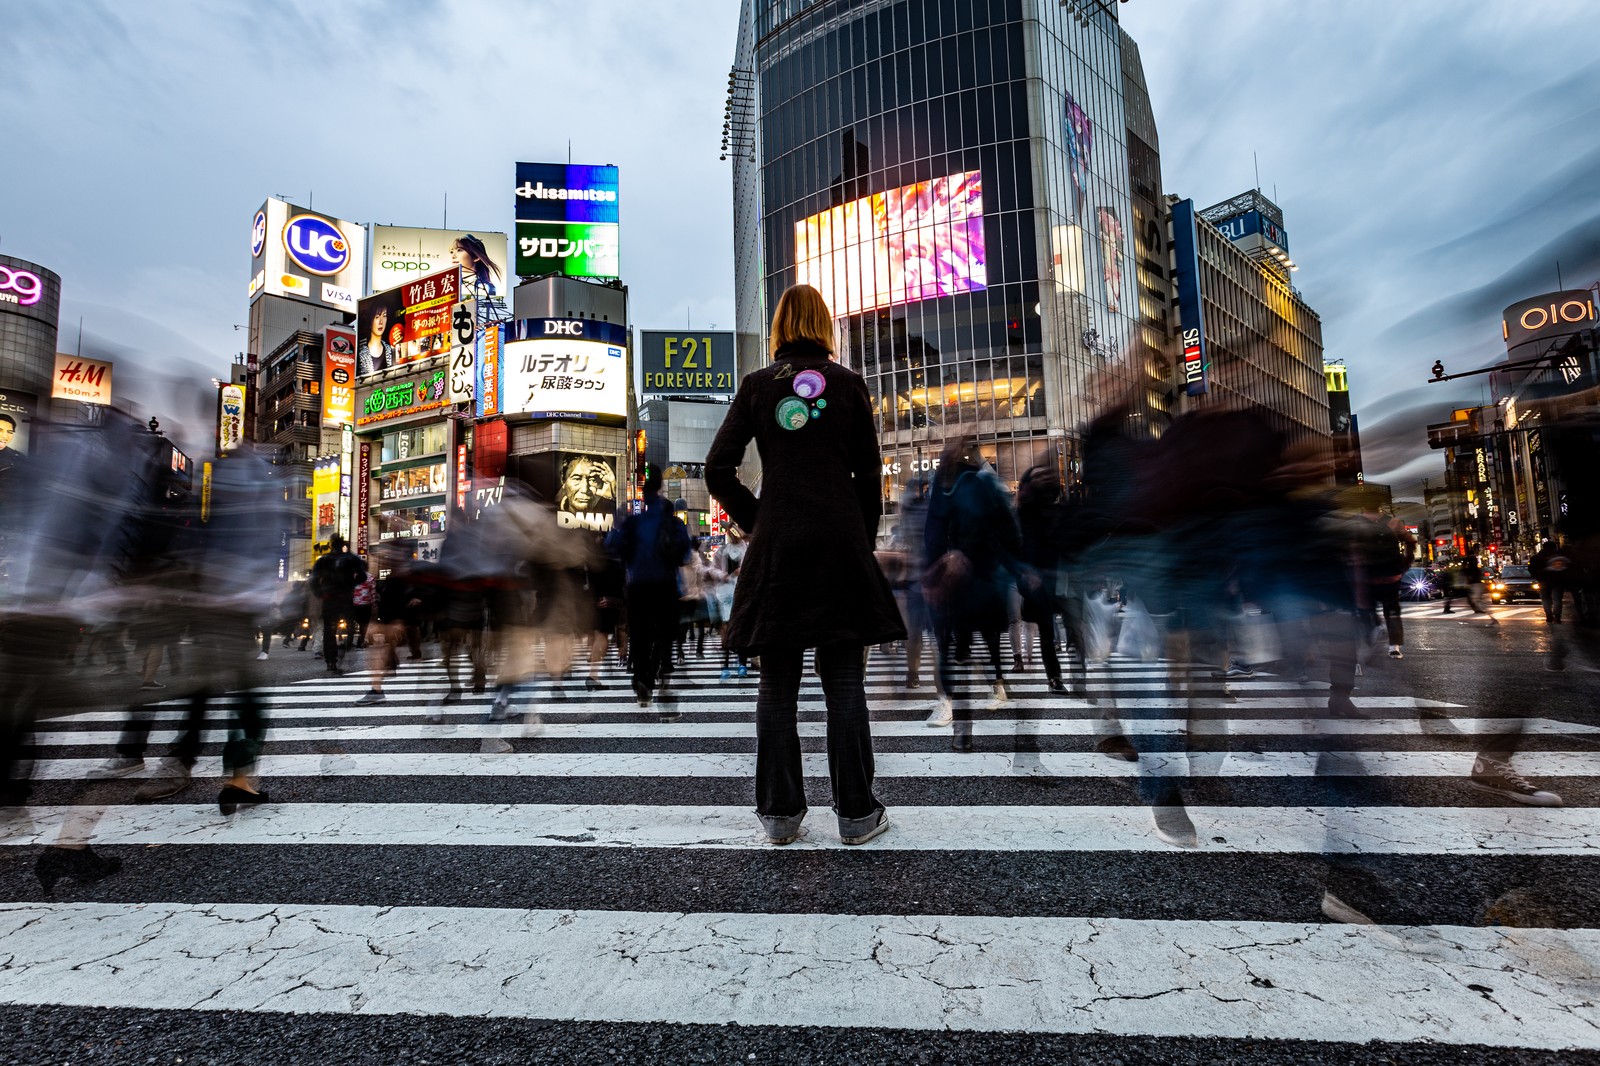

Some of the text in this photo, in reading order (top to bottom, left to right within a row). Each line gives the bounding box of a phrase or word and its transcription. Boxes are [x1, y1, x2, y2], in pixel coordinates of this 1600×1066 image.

[515, 181, 616, 201] Hisamitsu
[381, 260, 430, 272] oppo
[326, 288, 352, 302] VISA
[544, 320, 583, 335] DHC
[452, 303, 475, 398] もんじゃ
[664, 337, 712, 368] F21
[1183, 328, 1202, 383] SEIBU
[59, 360, 106, 387] H&M
[484, 329, 495, 411] 三千里薬品
[645, 372, 731, 388] FOREVER 21
[541, 375, 605, 391] 尿酸ダウン
[1475, 447, 1487, 482] KARAOKE
[383, 483, 429, 499] Euphoria
[557, 510, 614, 532] DMM
